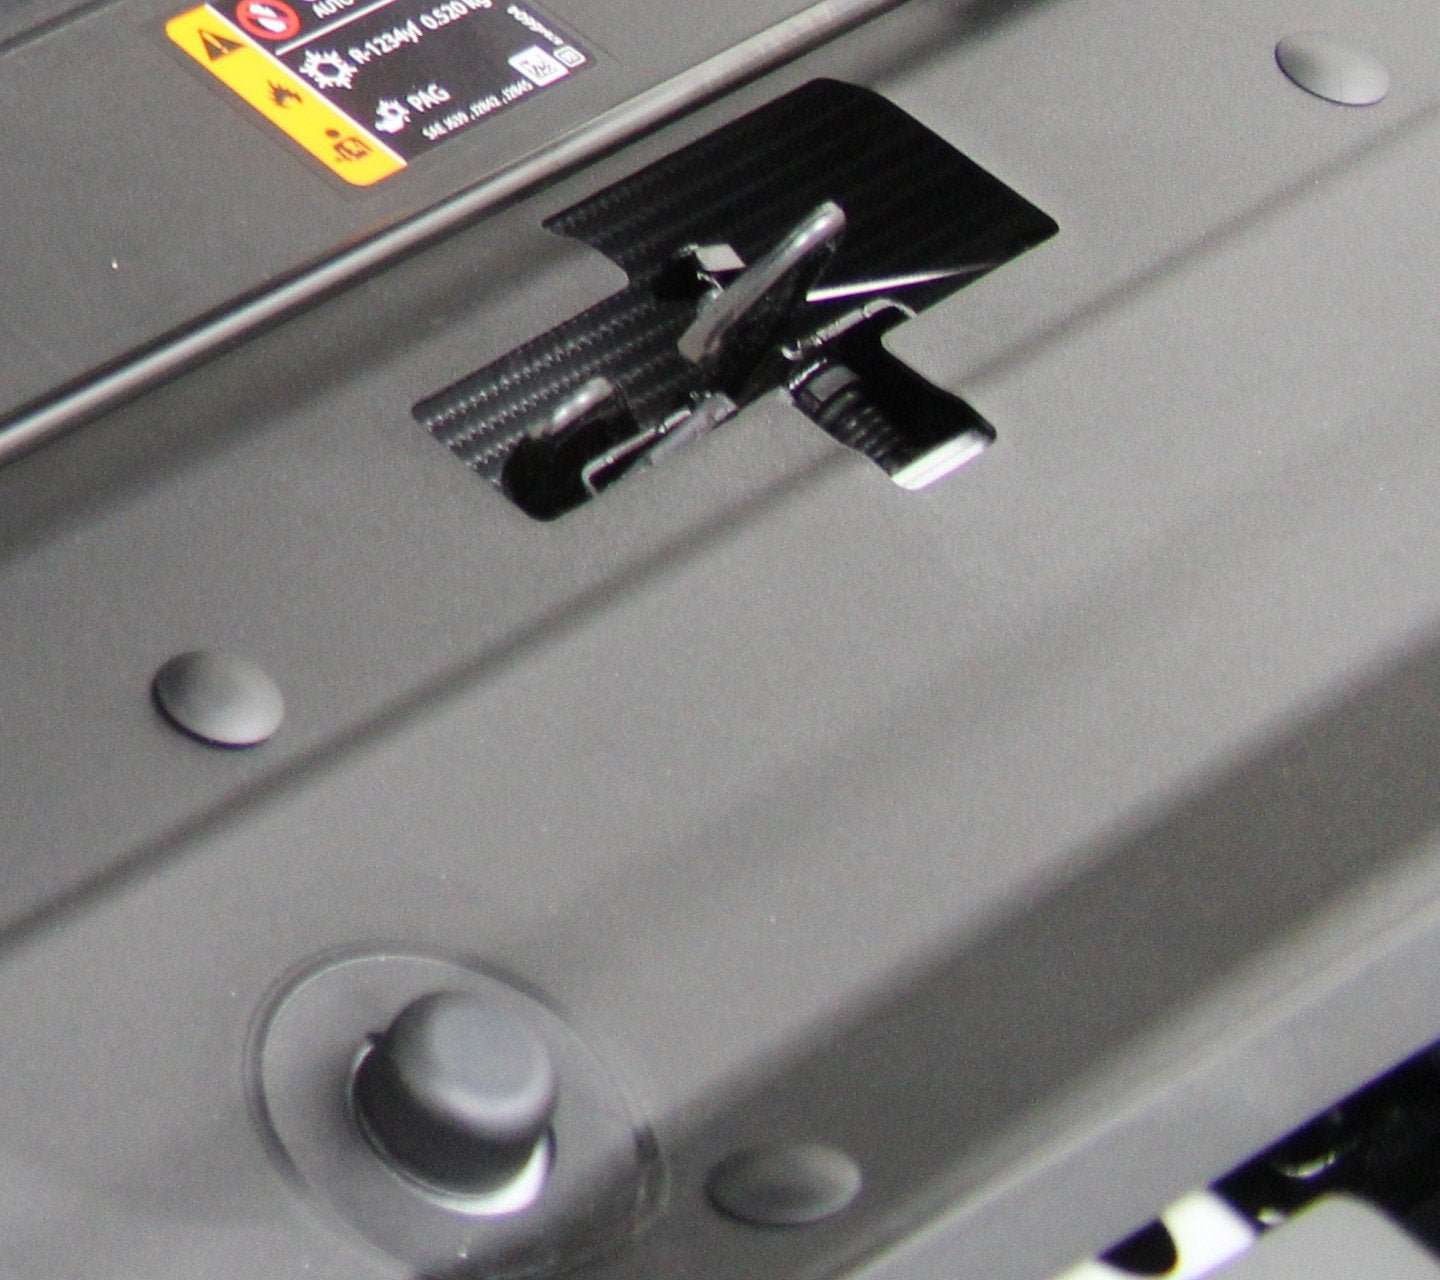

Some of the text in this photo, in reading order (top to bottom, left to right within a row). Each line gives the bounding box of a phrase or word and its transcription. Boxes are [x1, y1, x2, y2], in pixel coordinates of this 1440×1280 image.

[347, 19, 424, 65] R-1234yf
[419, 0, 468, 31] 0.520
[406, 81, 453, 113] PAG
[422, 120, 448, 141] SAE
